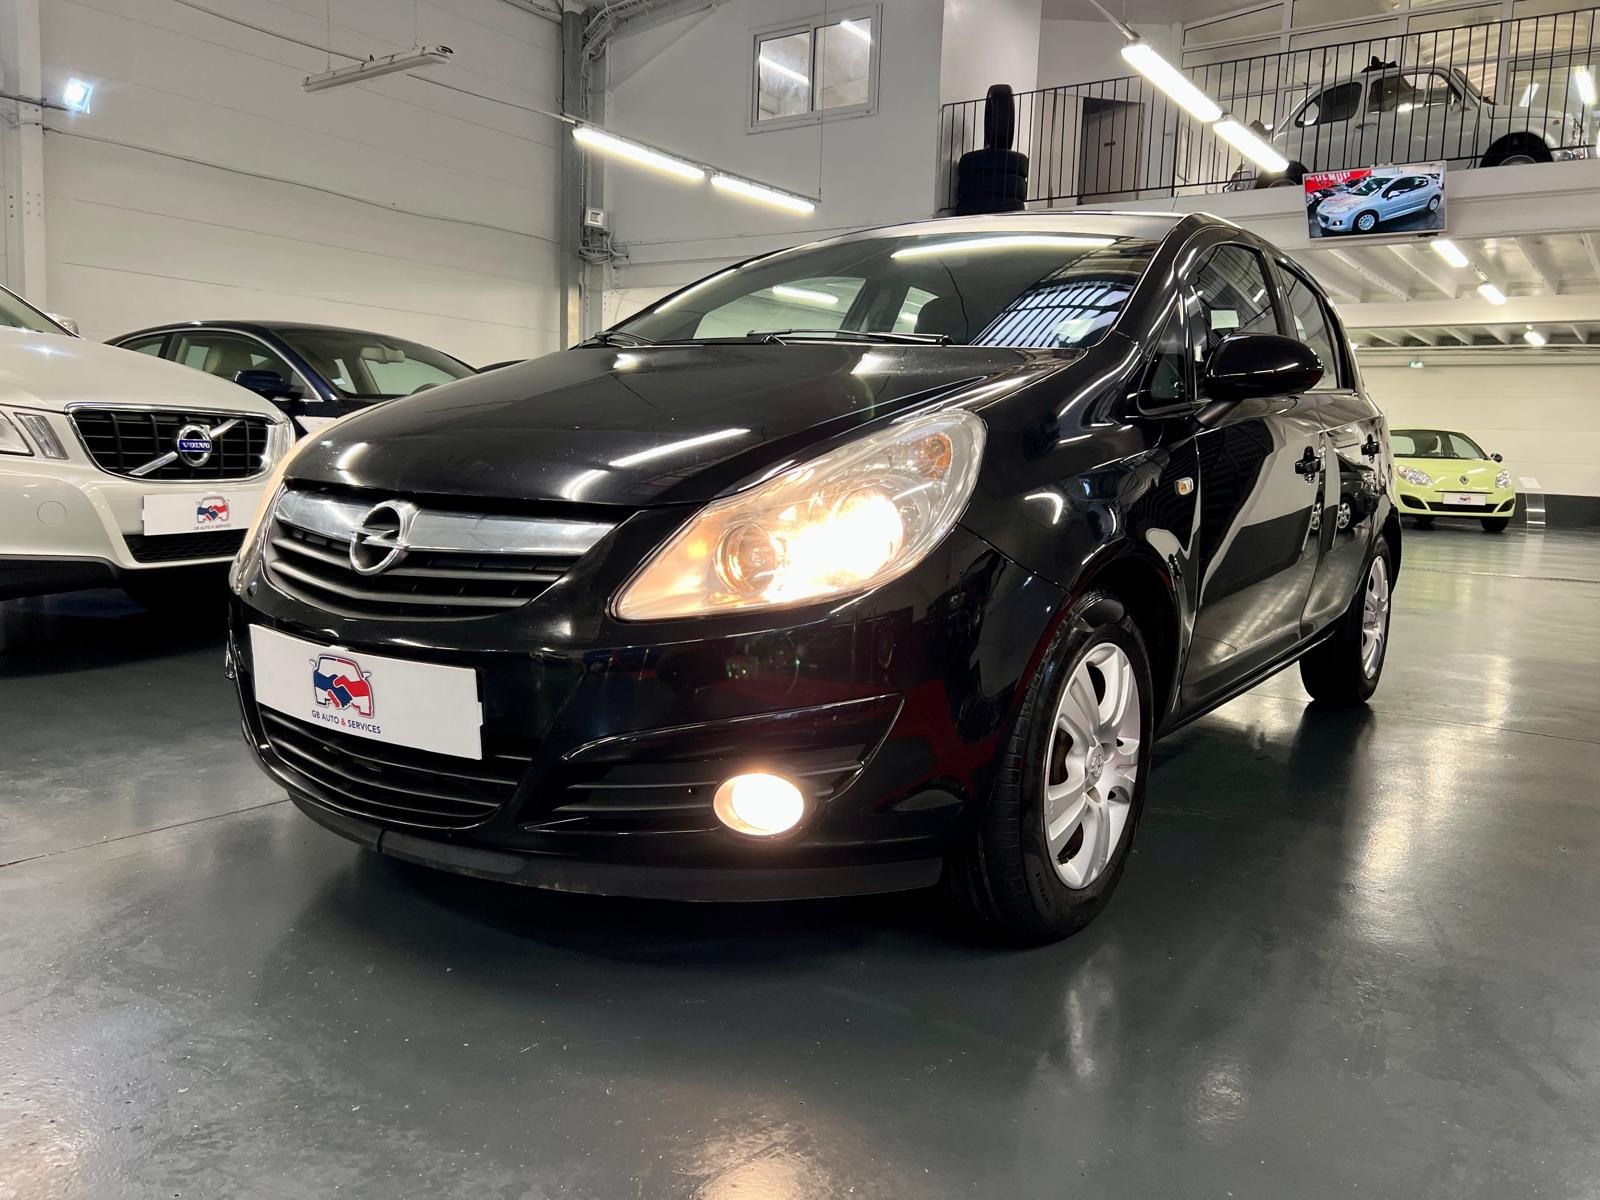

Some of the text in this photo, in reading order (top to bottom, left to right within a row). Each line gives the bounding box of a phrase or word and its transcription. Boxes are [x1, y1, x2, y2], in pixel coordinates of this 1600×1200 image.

[312, 710, 381, 734] GB AUTO & SERVICES
